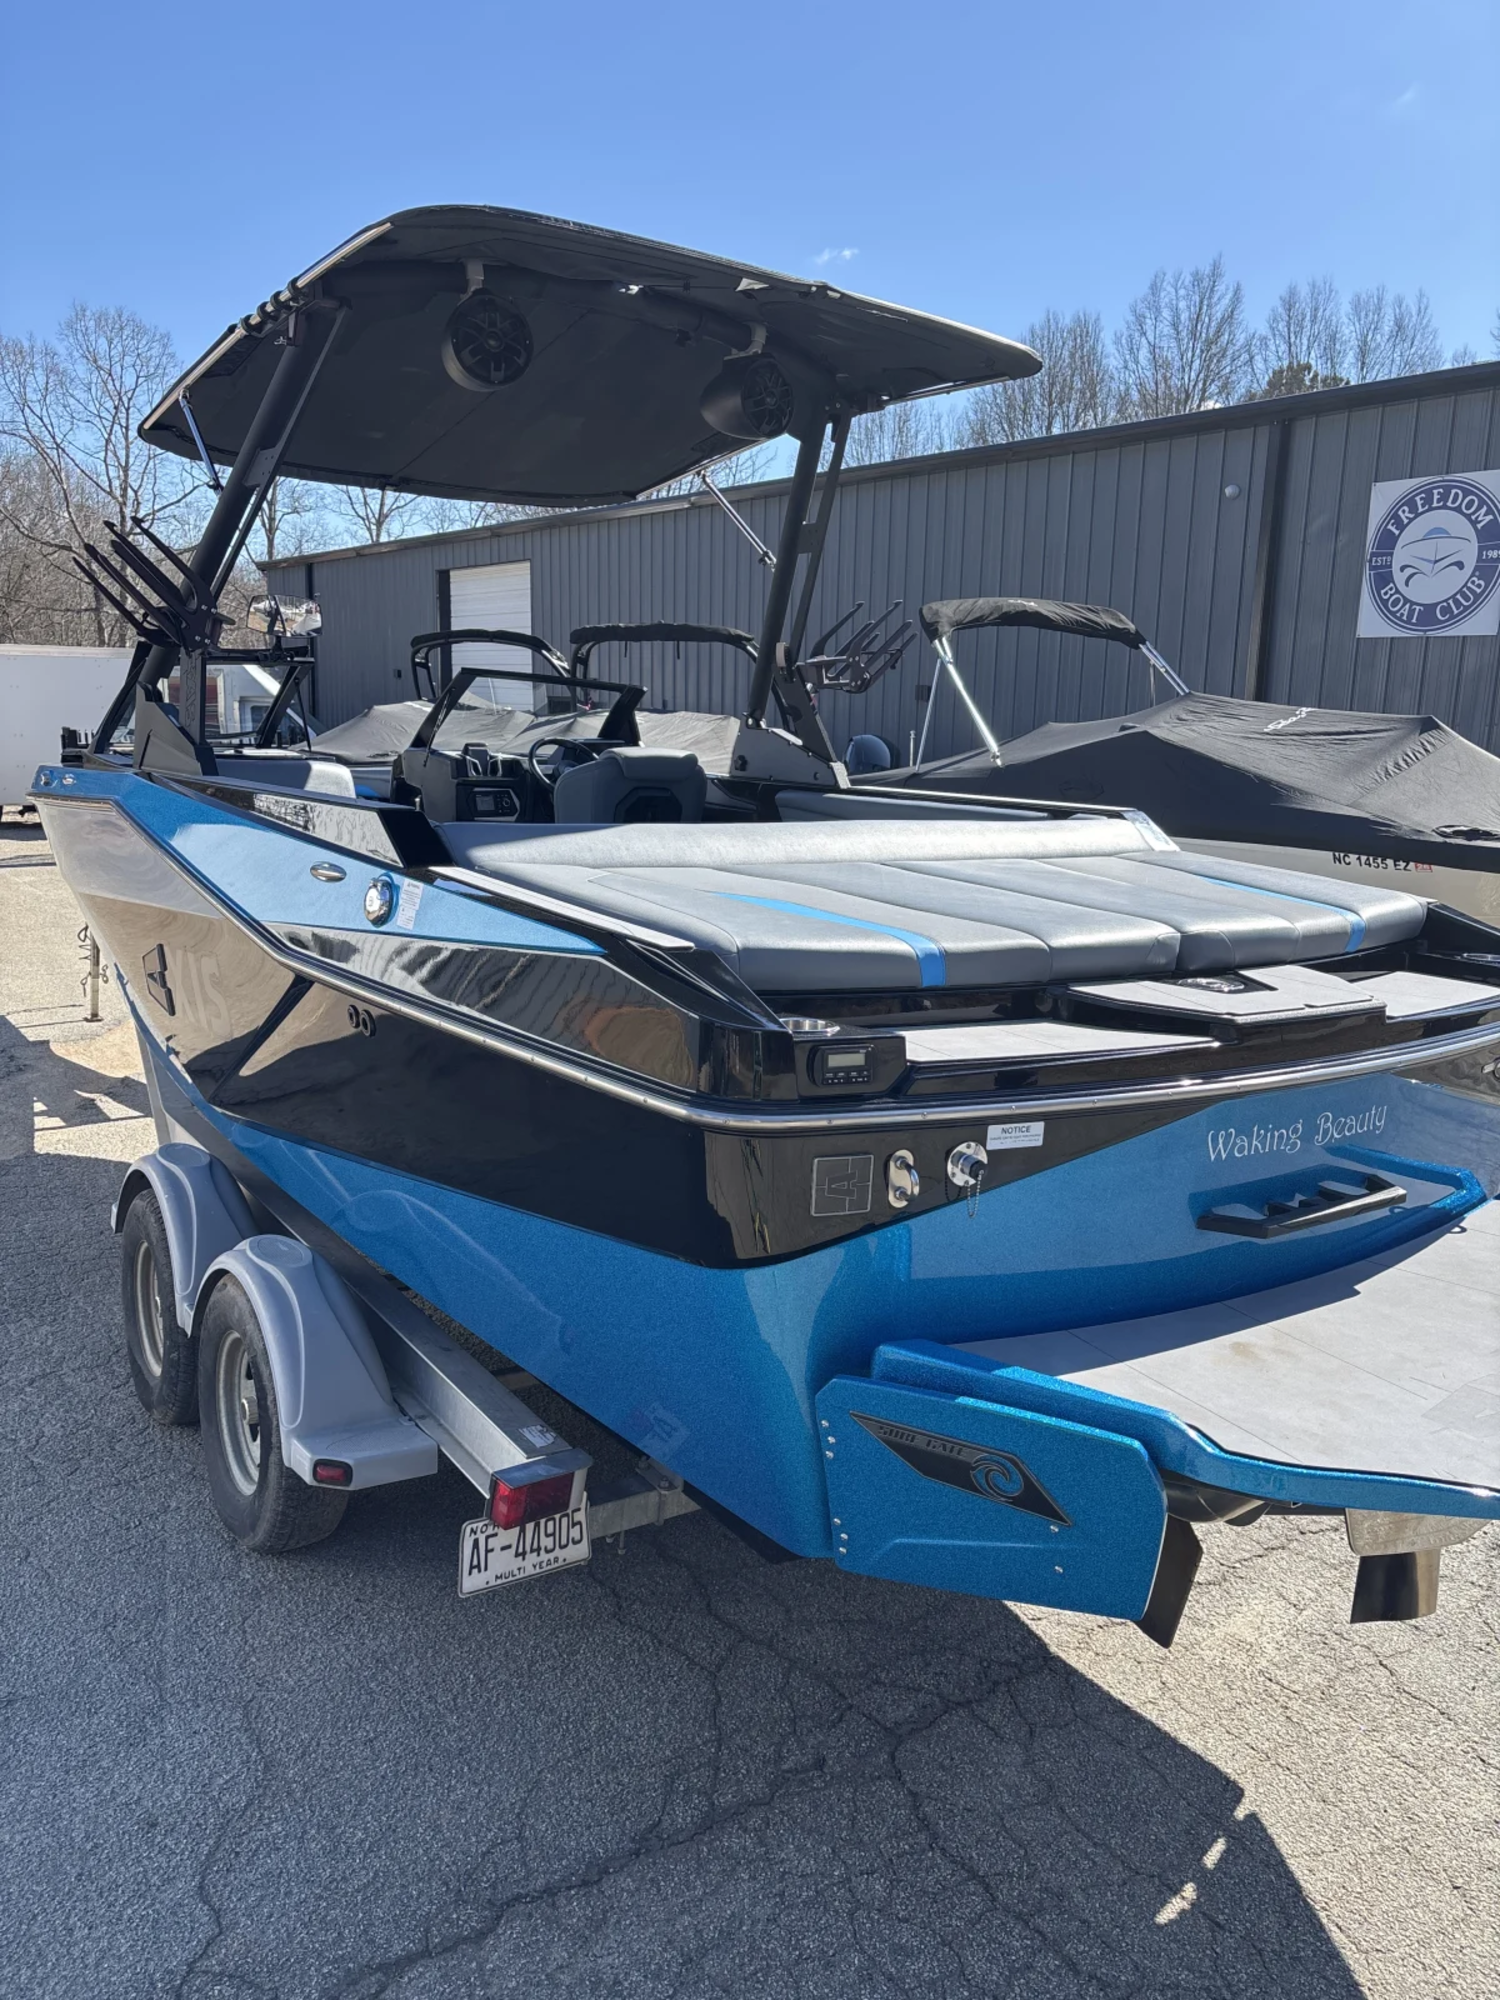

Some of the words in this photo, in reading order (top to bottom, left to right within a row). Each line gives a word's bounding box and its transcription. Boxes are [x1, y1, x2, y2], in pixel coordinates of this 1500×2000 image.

[1387, 488, 1494, 536] FREEDOM
[1380, 583, 1424, 623] BOAT
[1435, 576, 1485, 621] CLUB
[1332, 852, 1351, 866] NC
[1356, 856, 1388, 870] 1455
[1393, 860, 1412, 872] EZ
[1001, 1125, 1031, 1135] NOTICE
[1208, 1119, 1303, 1162] Waking
[1314, 1105, 1388, 1146] Beauty
[468, 1507, 583, 1577] AF-44905
[495, 1567, 526, 1583] MULTI
[532, 1557, 560, 1570] YEAR
